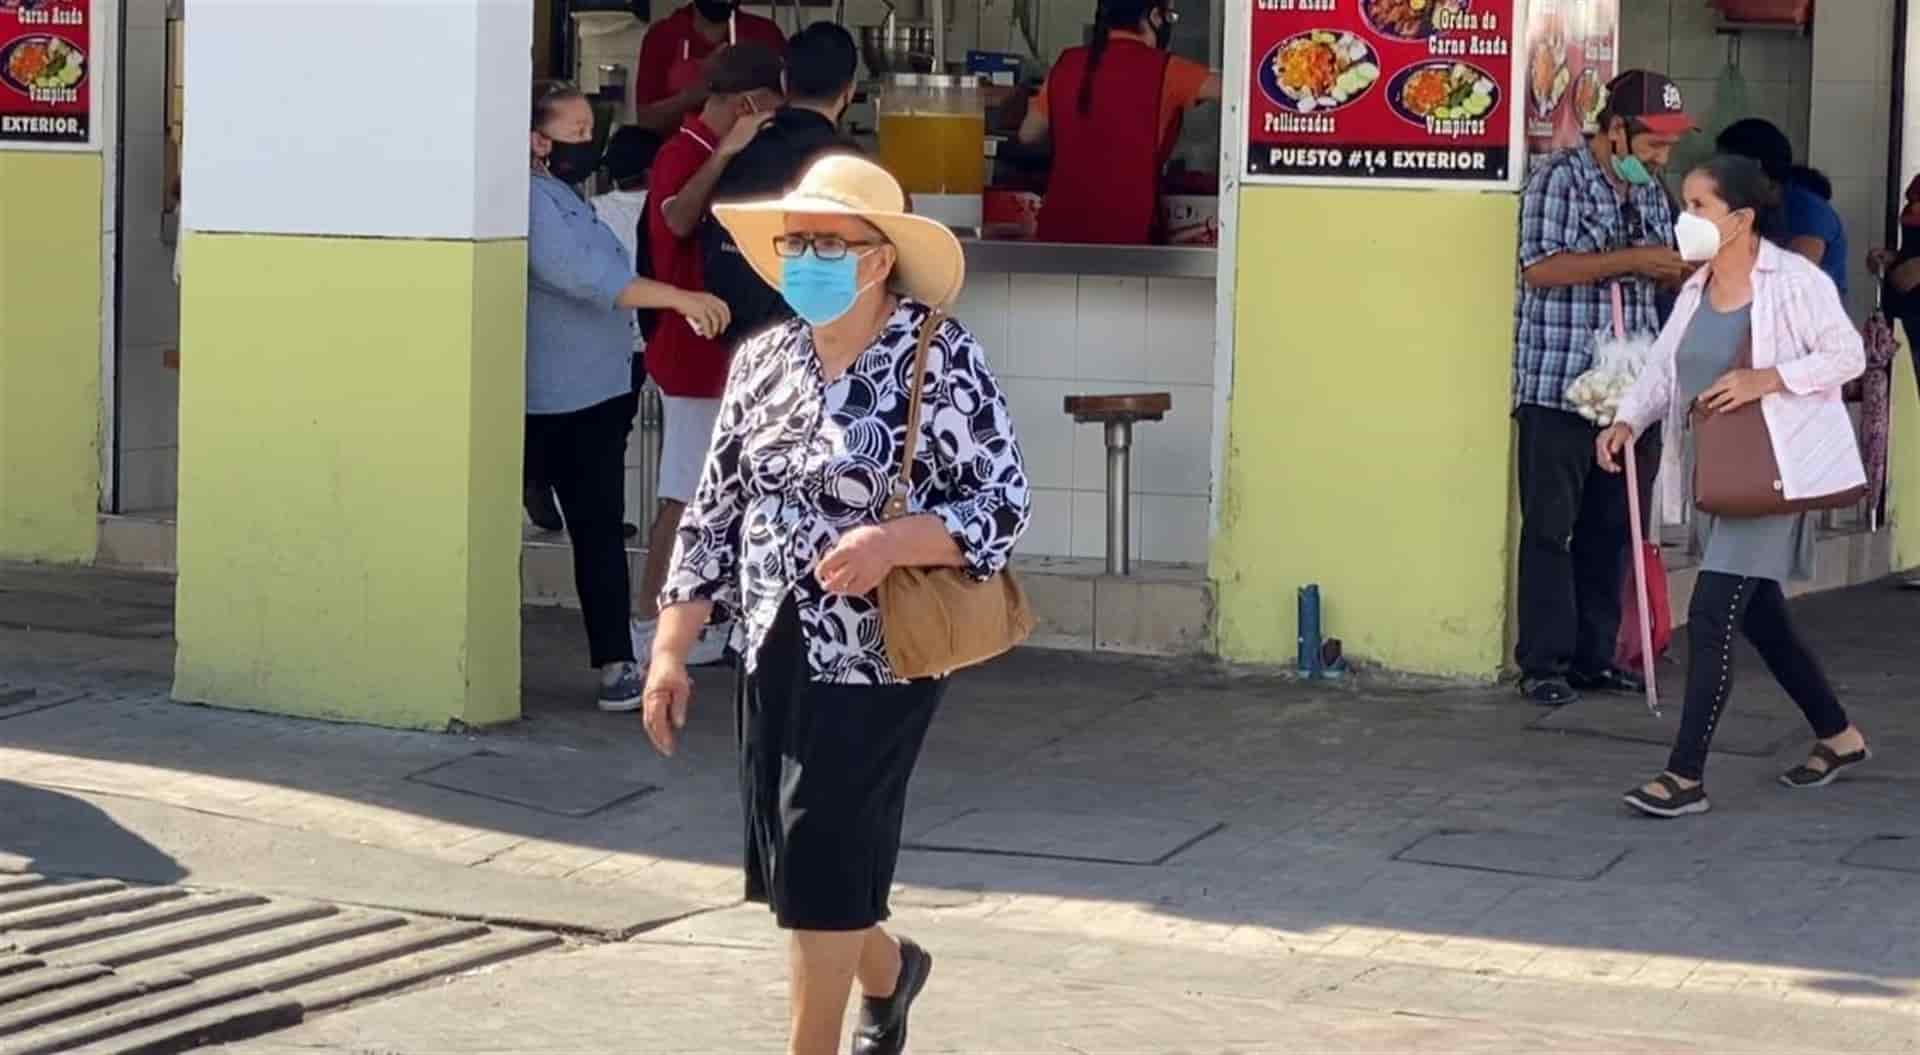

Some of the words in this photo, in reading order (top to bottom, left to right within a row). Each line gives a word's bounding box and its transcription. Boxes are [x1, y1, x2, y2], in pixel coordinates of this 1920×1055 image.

[17, 7, 49, 24] Carne
[51, 7, 83, 25] Asada
[1441, 9, 1478, 30] Orden
[1482, 10, 1497, 30] de
[1428, 35, 1466, 54] Carne
[1470, 35, 1508, 55] Asada
[28, 84, 77, 106] Vampiros
[1264, 112, 1335, 133] Pelliscadas
[1426, 115, 1485, 139] Vampiros
[1270, 149, 1342, 167] PUESTO
[1348, 150, 1387, 167] #14
[1392, 152, 1486, 169] EXTERIOR
